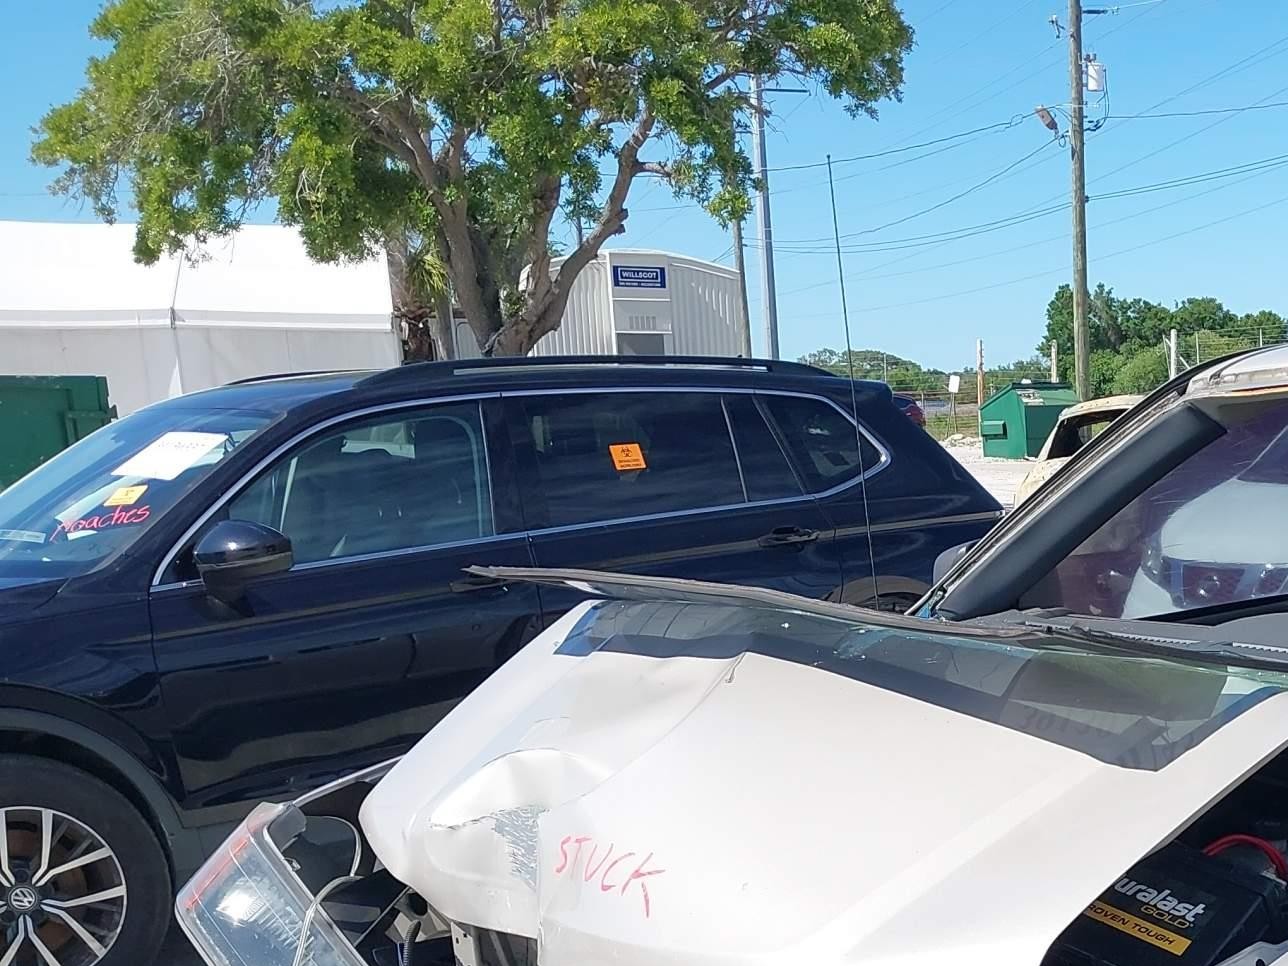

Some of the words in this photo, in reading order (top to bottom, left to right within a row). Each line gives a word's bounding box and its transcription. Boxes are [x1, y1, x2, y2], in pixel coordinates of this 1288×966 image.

[621, 271, 657, 279] WILLSCOT
[555, 836, 666, 918] STUCK
[1114, 877, 1207, 922] uralast
[1140, 905, 1189, 929] GOLD
[1087, 904, 1130, 926] ROVEN
[1132, 922, 1176, 946] TOUGH
